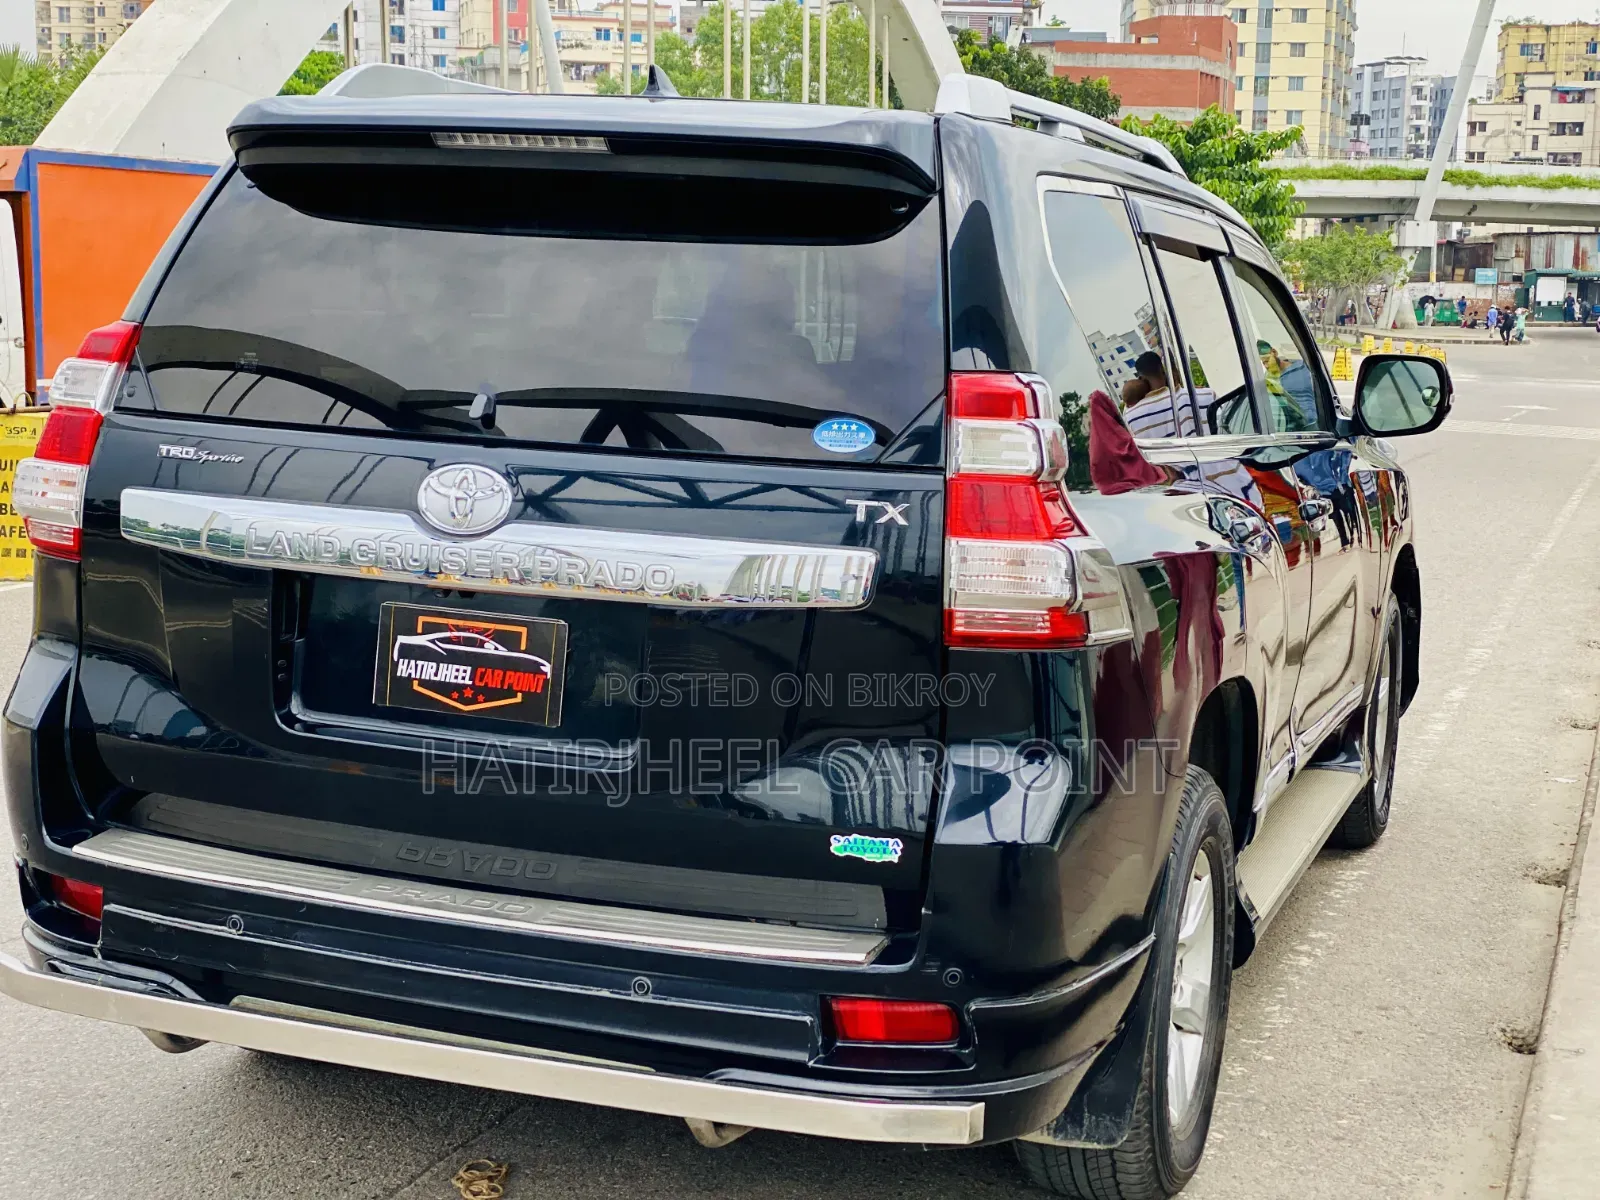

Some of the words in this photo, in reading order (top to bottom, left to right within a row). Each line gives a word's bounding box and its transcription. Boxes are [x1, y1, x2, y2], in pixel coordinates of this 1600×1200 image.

[157, 444, 197, 459] TRD
[845, 498, 910, 526] TX
[246, 527, 341, 563] LAND
[350, 538, 521, 580] CRUISER
[533, 554, 675, 594] PRADO
[397, 658, 473, 685] HATIRJHEEL
[474, 667, 504, 688] CAR
[503, 669, 547, 693] POINT
[833, 836, 901, 848] SAITAMA
[841, 844, 899, 855] TOYOTA
[362, 883, 536, 915] PRADO
